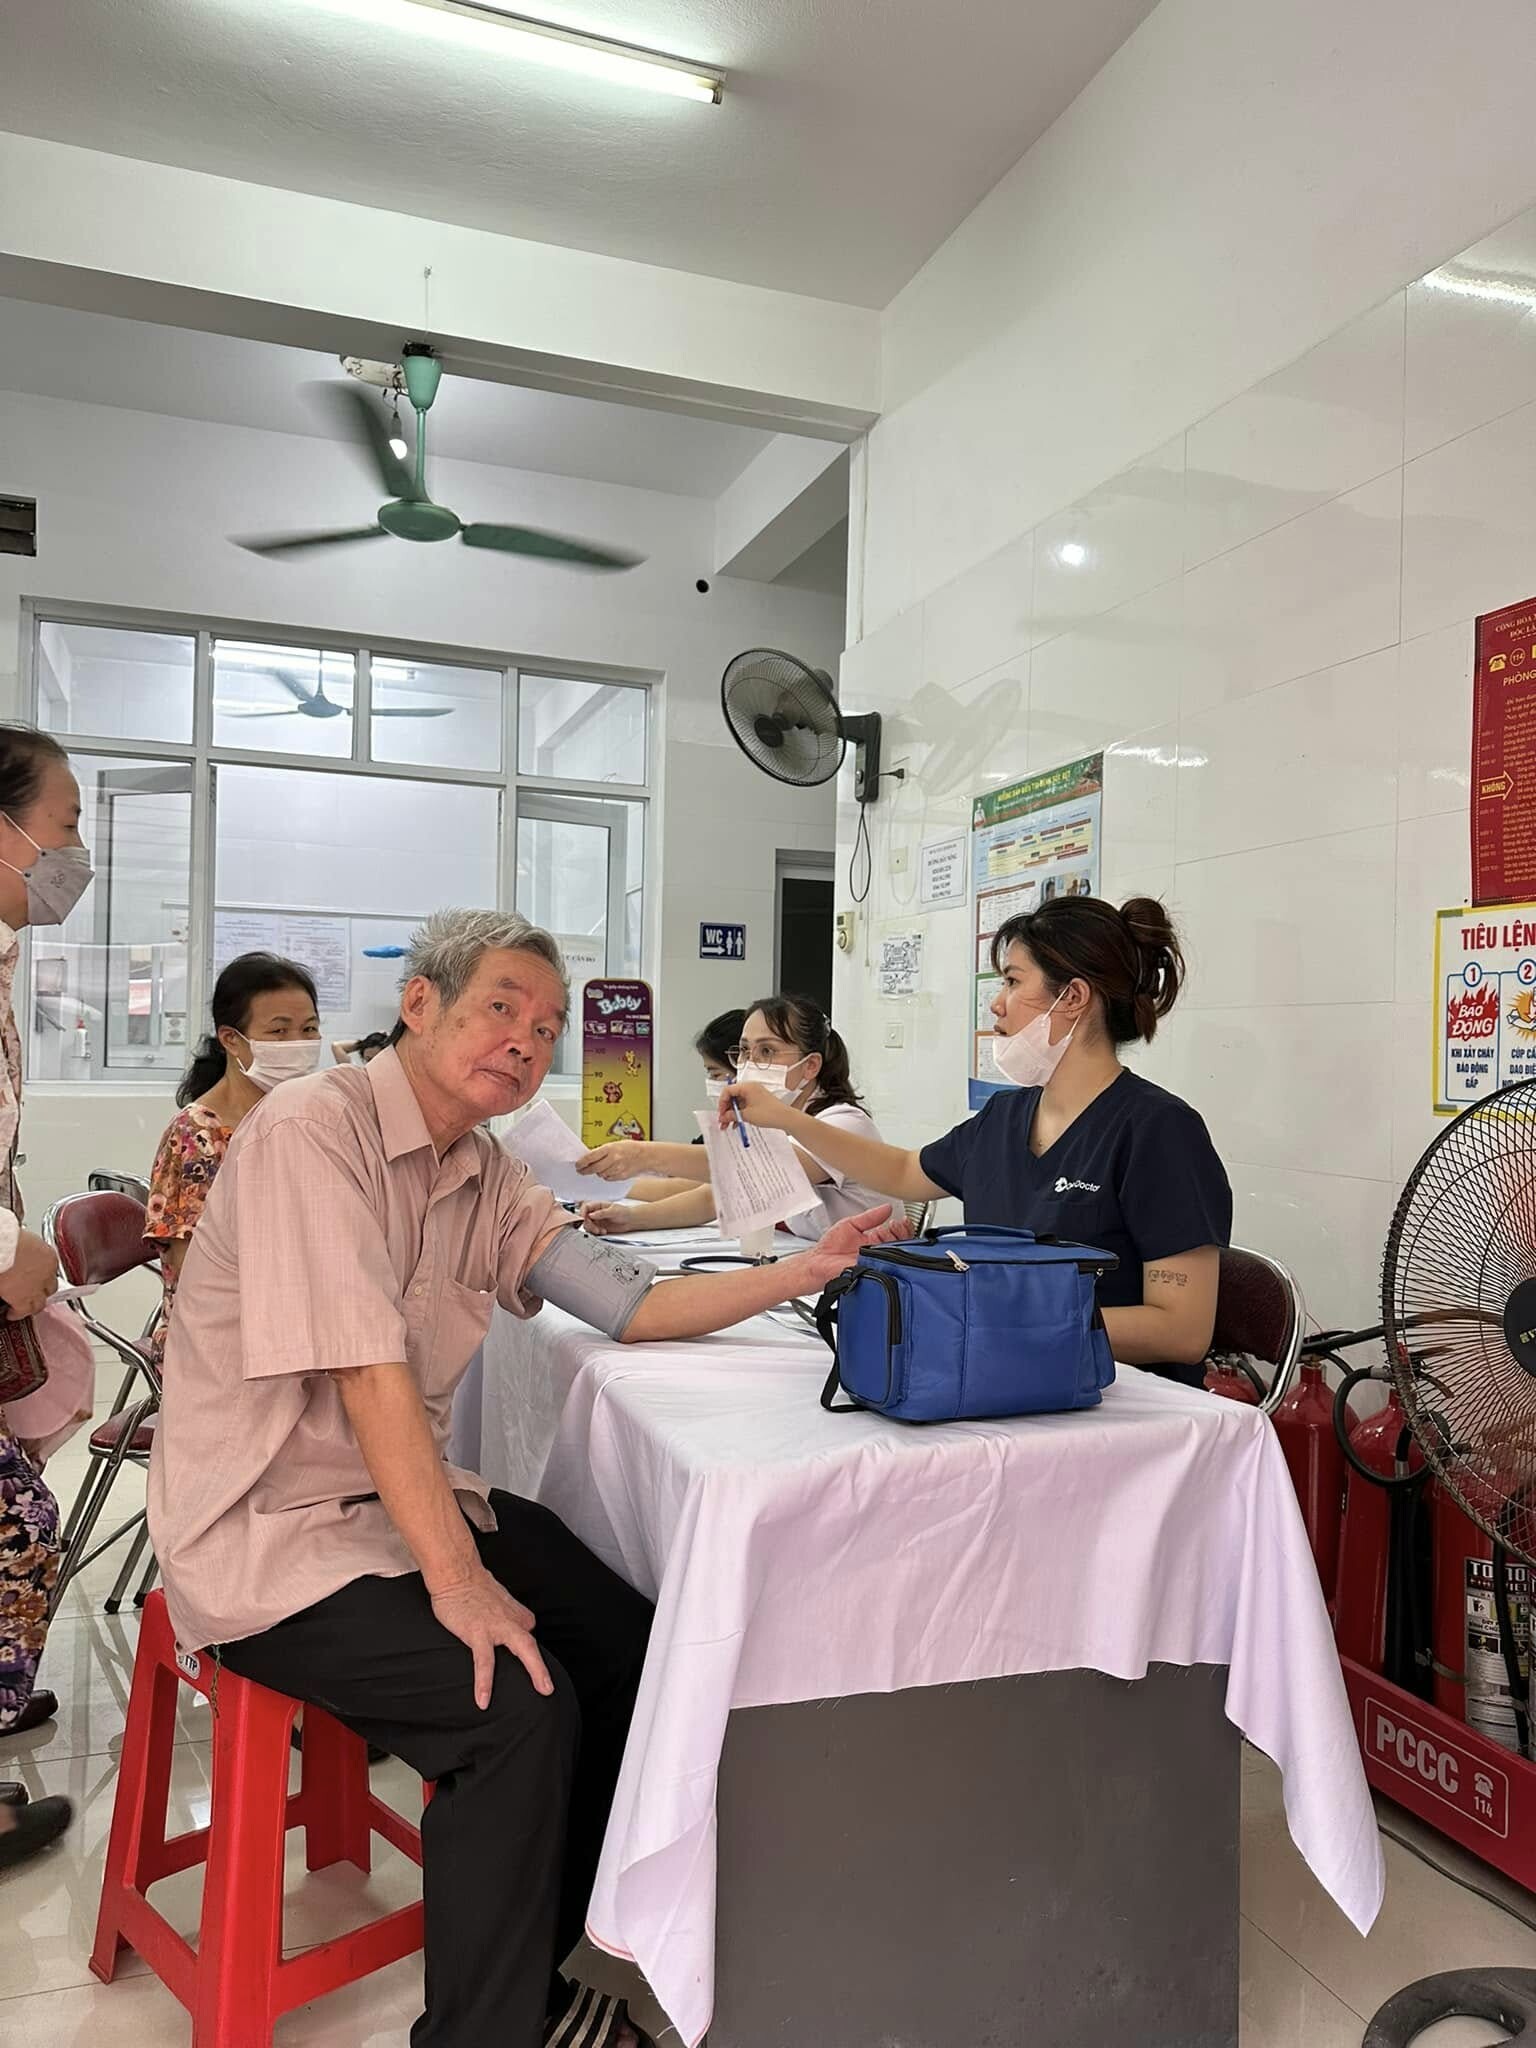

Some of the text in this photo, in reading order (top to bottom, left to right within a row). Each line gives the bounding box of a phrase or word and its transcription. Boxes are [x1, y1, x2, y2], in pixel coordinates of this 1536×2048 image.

[1503, 670, 1536, 686] PHÒNG
[705, 928, 723, 944] WC
[1461, 919, 1536, 952] TIÊU LỆN
[1470, 967, 1476, 982] 1
[1523, 964, 1532, 980] 2
[597, 994, 642, 1014] Bobby
[1458, 1002, 1484, 1018] BÁO
[1452, 1018, 1493, 1040] ĐỘNG
[1377, 1714, 1459, 1794] PCCC
[1474, 1796, 1493, 1818] 114
